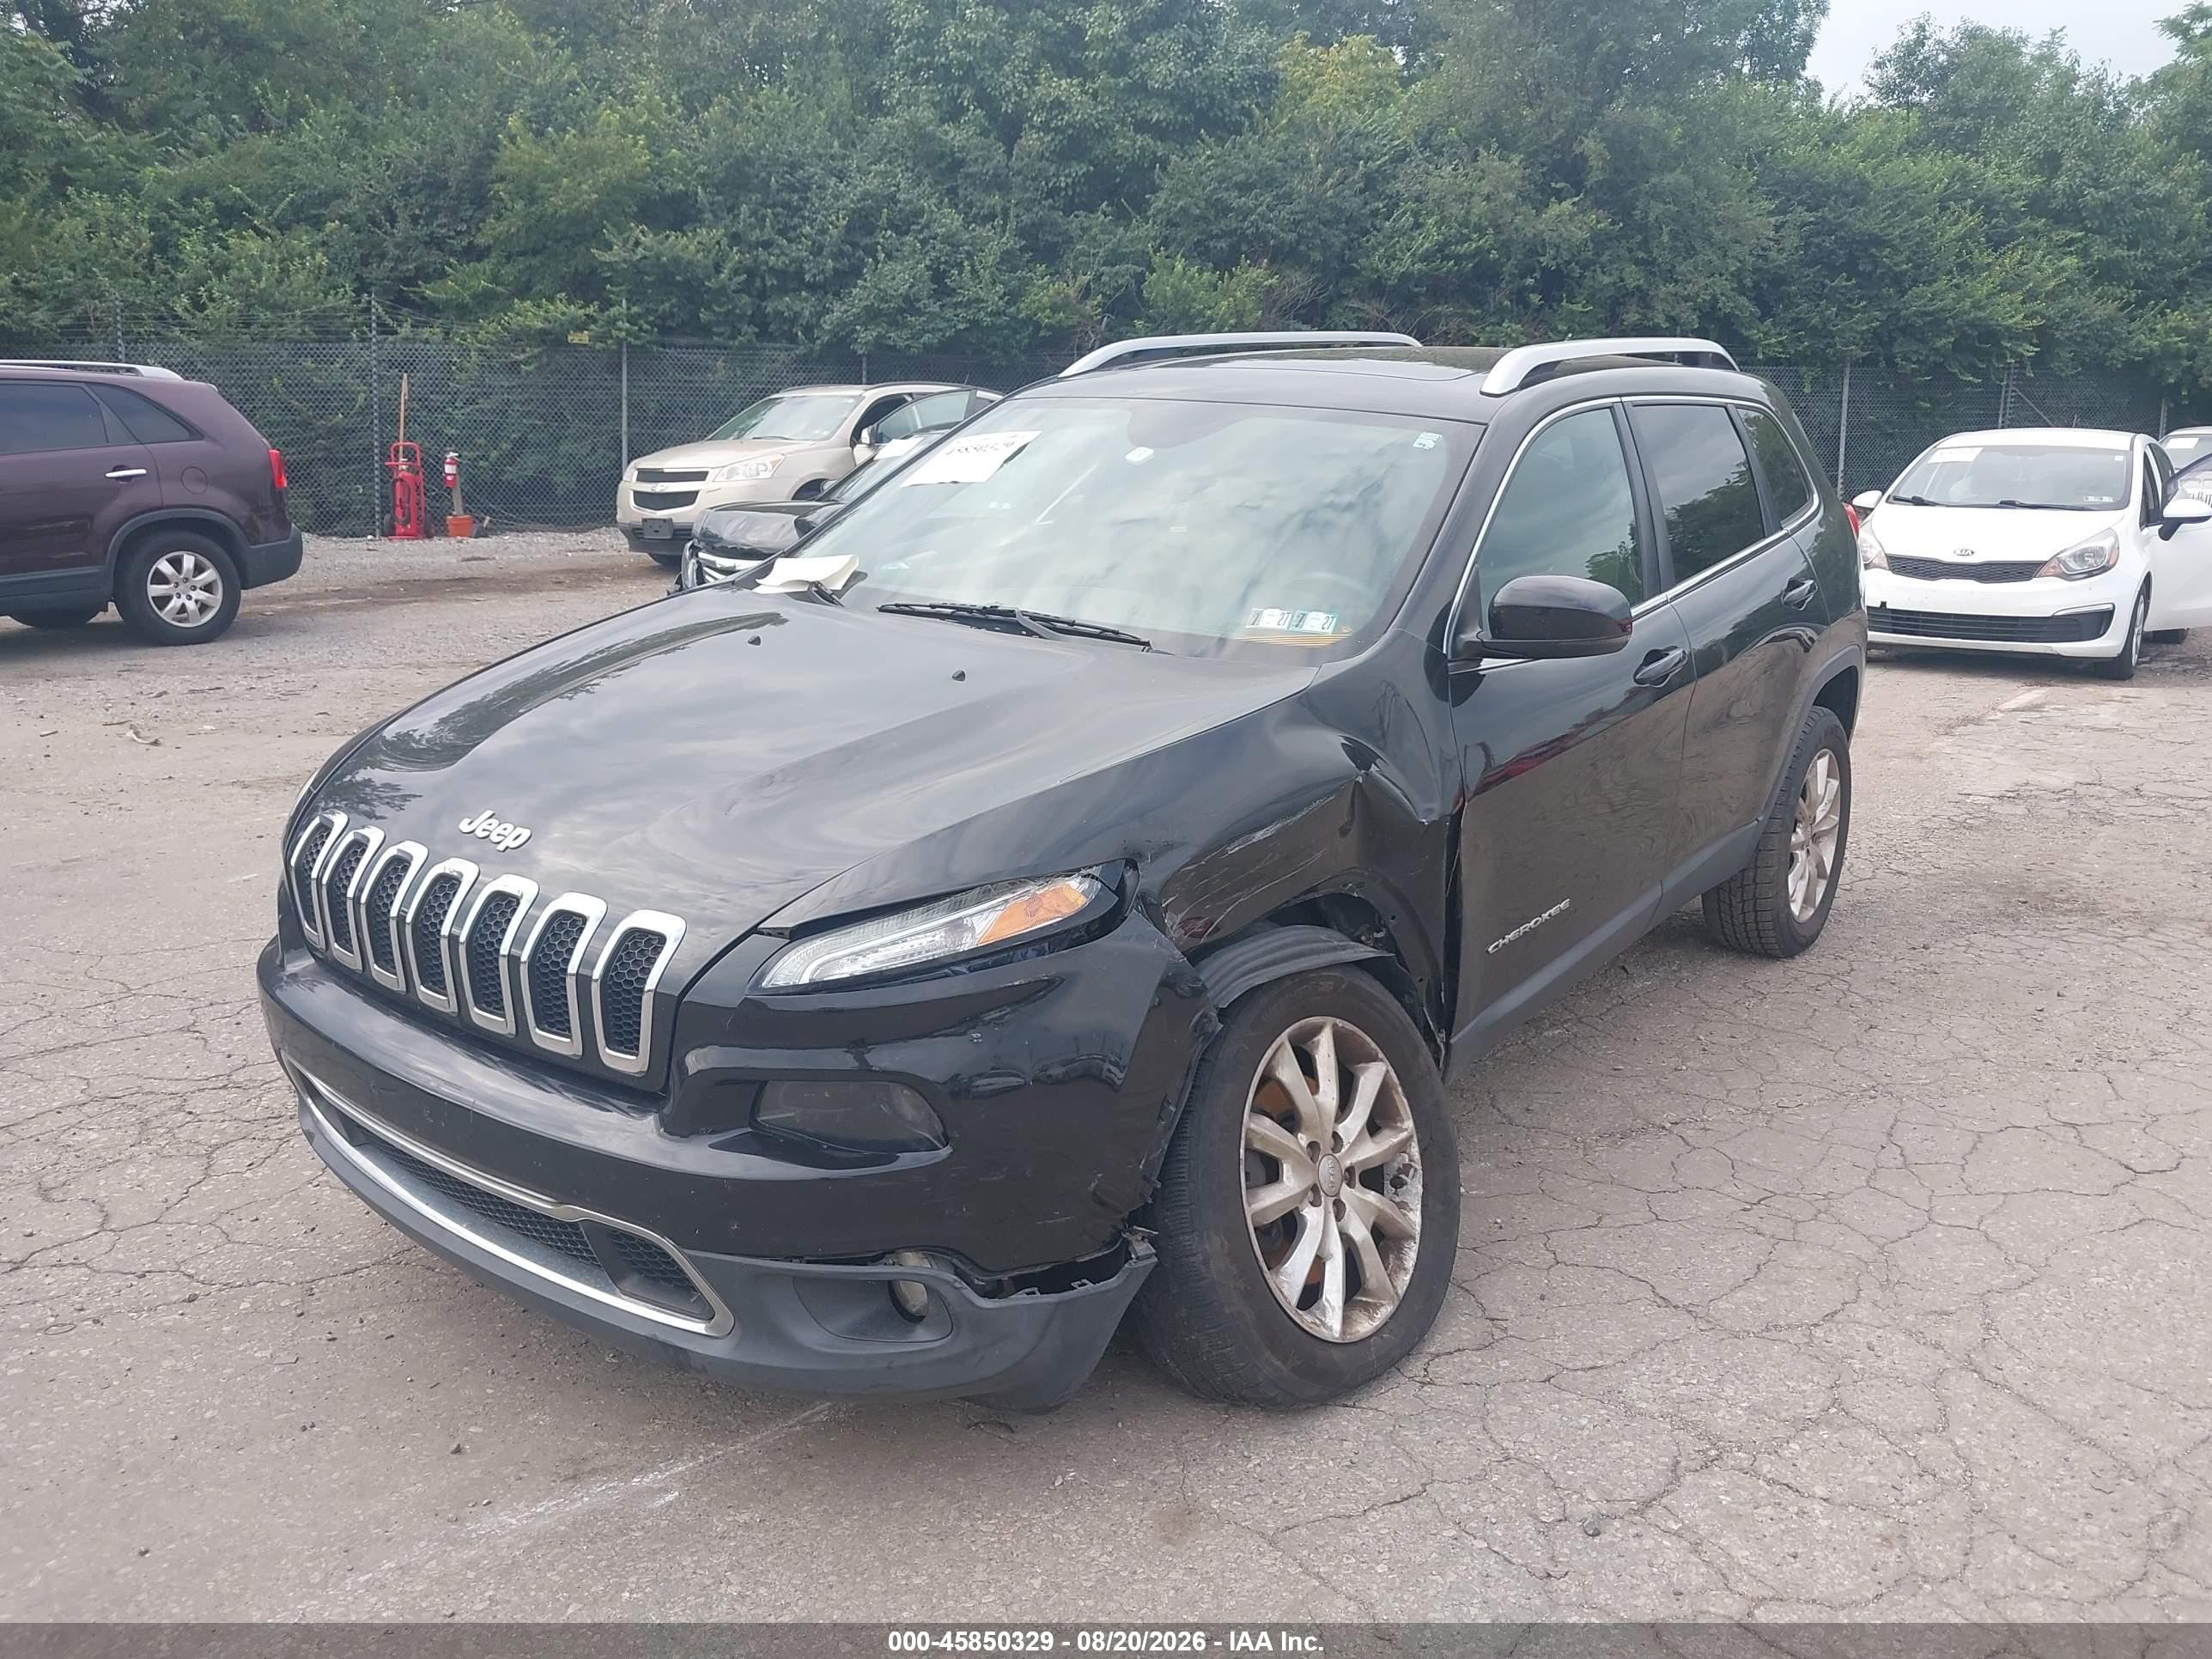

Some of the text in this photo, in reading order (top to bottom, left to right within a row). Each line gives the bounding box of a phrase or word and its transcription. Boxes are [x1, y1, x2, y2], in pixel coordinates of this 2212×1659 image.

[1277, 612, 1291, 626] 27
[1322, 616, 1334, 630] 27
[459, 810, 532, 853] Jeep
[1487, 898, 1571, 954] CHEROKEE
